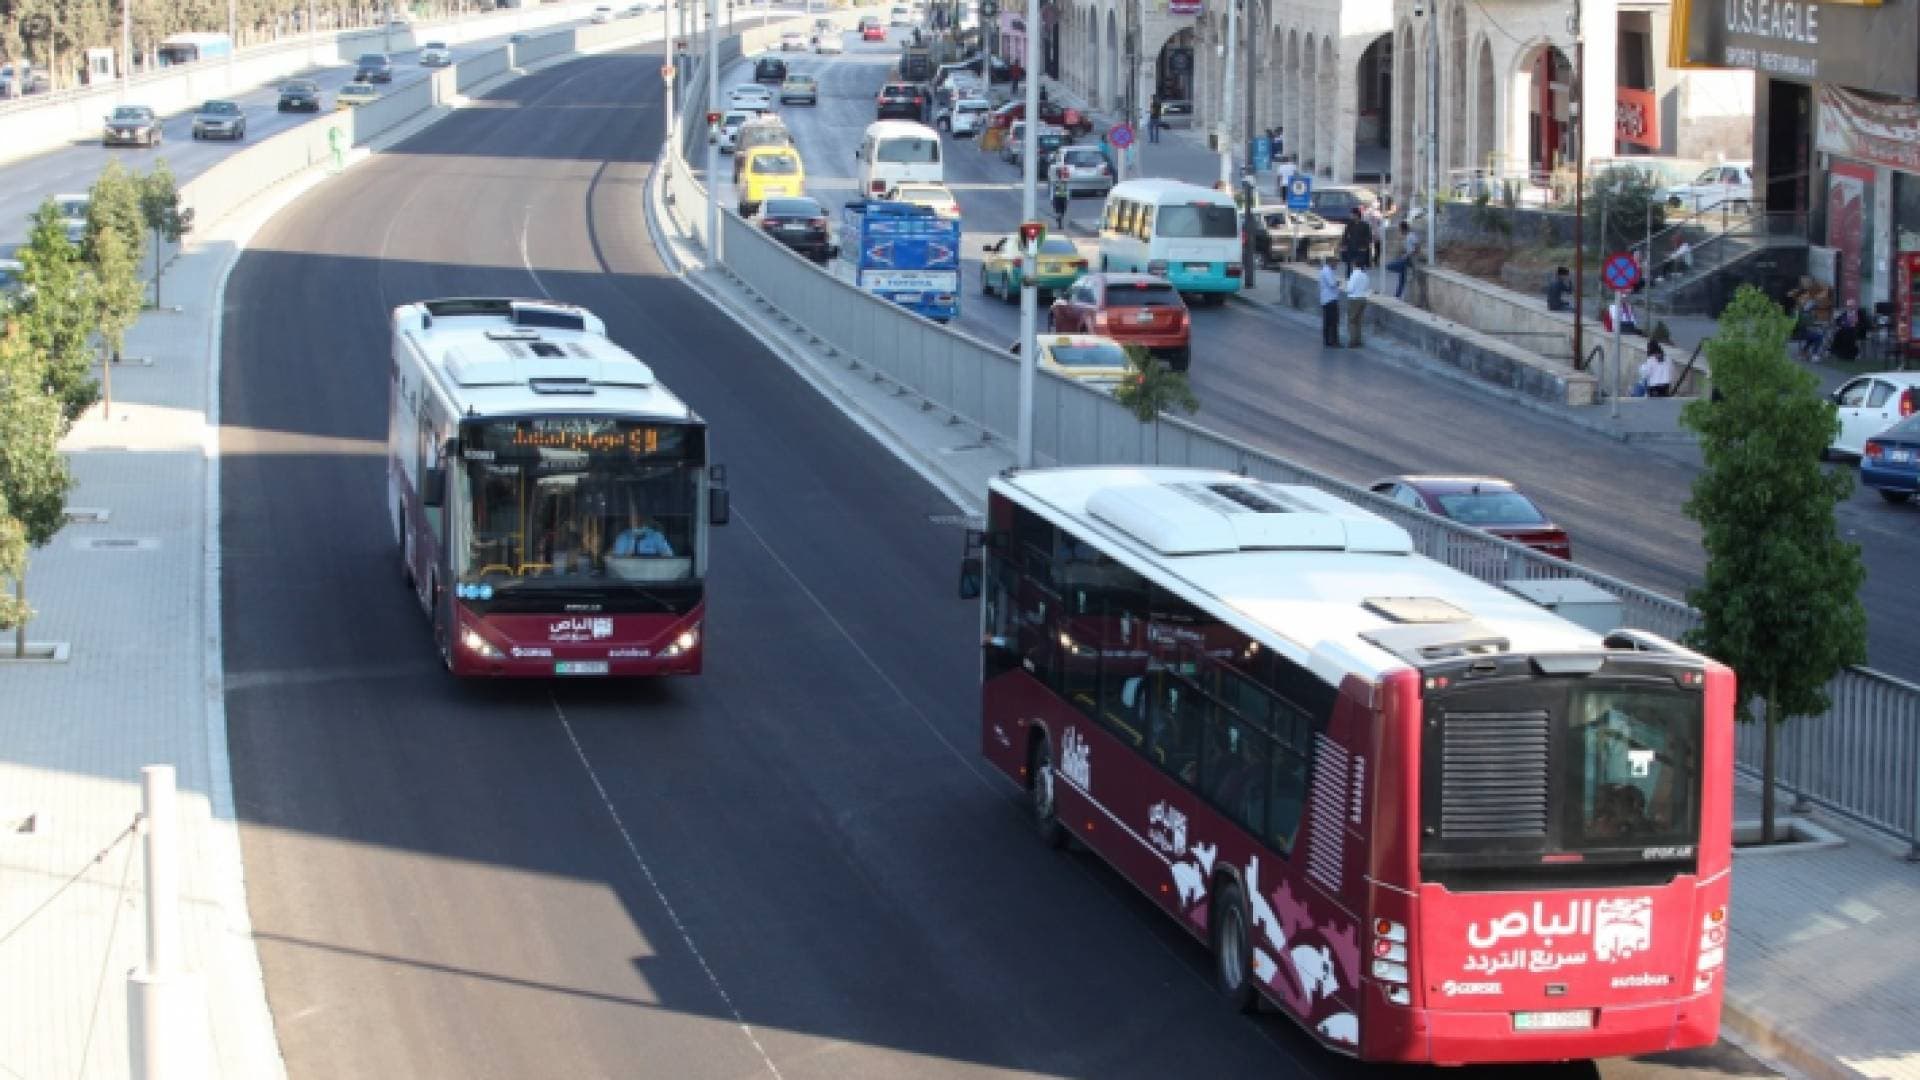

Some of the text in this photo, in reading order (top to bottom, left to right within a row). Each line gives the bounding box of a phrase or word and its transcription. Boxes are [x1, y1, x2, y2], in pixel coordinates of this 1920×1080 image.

[1467, 899, 1592, 949] الباص
[1463, 948, 1588, 975] سريع التردد
